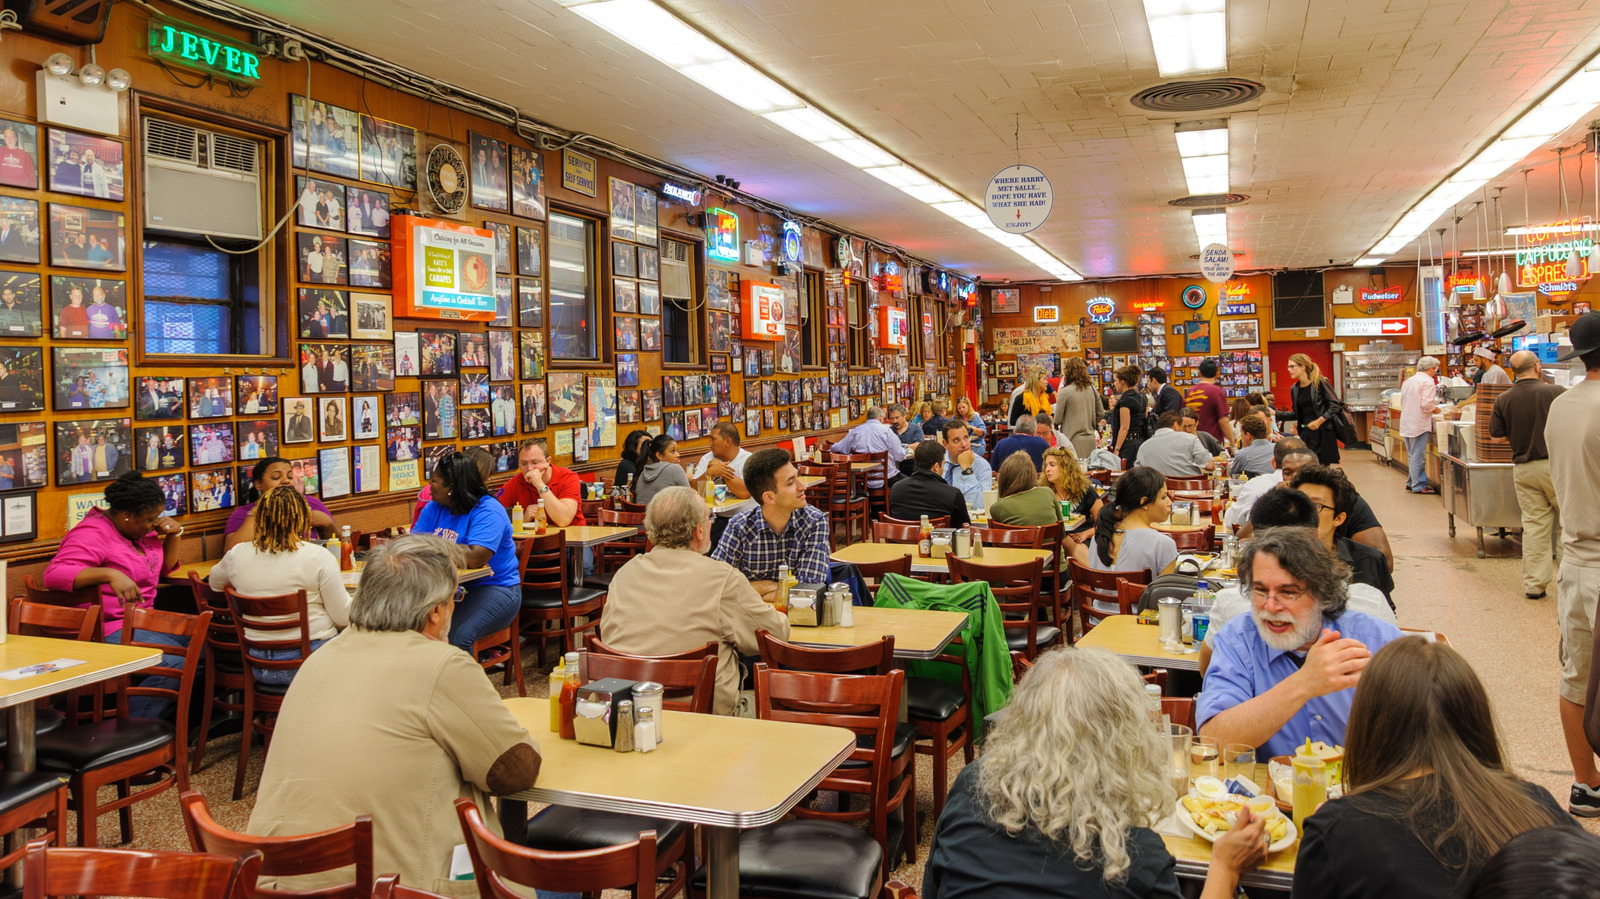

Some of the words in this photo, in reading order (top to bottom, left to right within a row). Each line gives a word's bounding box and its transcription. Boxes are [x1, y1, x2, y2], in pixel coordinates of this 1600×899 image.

[161, 25, 260, 79] JEVER
[568, 155, 592, 173] SERVICE
[565, 172, 576, 184] SELF
[576, 175, 593, 191] SERVICE
[992, 193, 1011, 201] HOPE
[1526, 218, 1581, 243] COFFEE
[429, 273, 452, 284] CANAPES
[1362, 292, 1399, 300] Budweiser
[1092, 304, 1110, 314] Pabst
[996, 330, 1008, 339] FOR
[1027, 329, 1058, 338] BUSINESS
[1010, 337, 1037, 346] HOLIDAY
[392, 464, 415, 474] WAITER
[392, 472, 416, 480] SERVICE
[76, 498, 111, 511] WAITE
